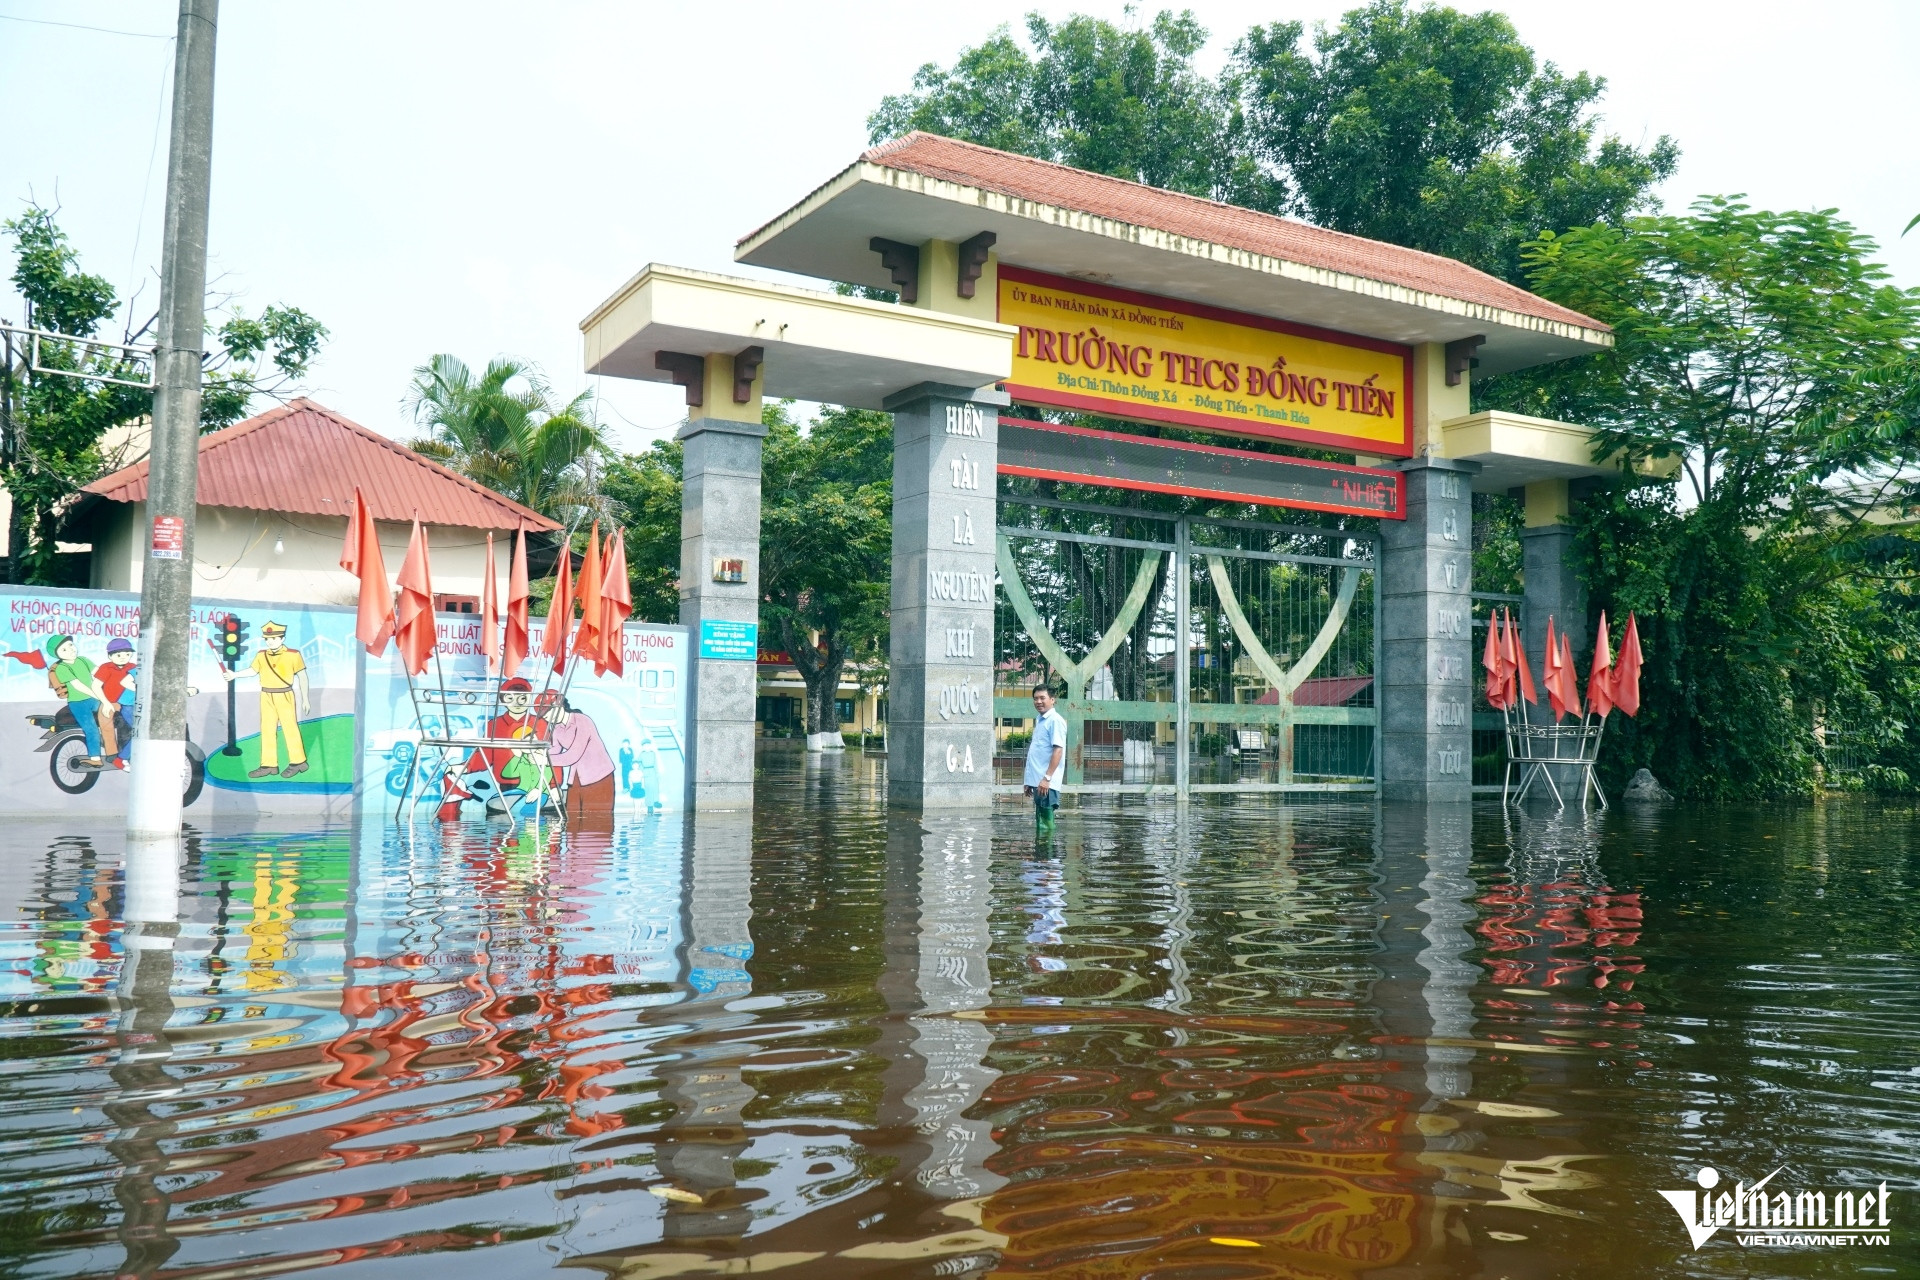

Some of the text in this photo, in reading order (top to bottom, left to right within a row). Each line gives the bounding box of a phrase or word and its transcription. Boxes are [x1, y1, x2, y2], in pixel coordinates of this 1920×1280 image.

[1012, 287, 1184, 331] ỦY BAN NHÂN DÂN XÃ ĐỒNG TIẾN
[1016, 324, 1396, 419] TRƯỜNG THCS ĐỒNG TIẾN
[1057, 372, 1076, 388] Địa
[1100, 380, 1129, 395] Thôn
[1161, 389, 1177, 403] Xá
[1255, 404, 1288, 420] Thanh
[1290, 410, 1310, 424] Hóa
[945, 403, 984, 437] HIỀN
[951, 452, 979, 490] TÀI
[953, 509, 975, 545] LÀ
[930, 566, 990, 602] NGUYÊN
[11, 599, 60, 616] KHÔNG
[65, 601, 111, 618] PHÓNG
[10, 616, 26, 633] VÀ
[29, 616, 55, 634] CHỞ
[58, 618, 84, 635] QUÁ
[86, 619, 104, 636] SỐ
[105, 620, 140, 638] NGƯỜ
[451, 623, 482, 641] LUẬT
[633, 633, 674, 648] THÔNG
[945, 622, 975, 657] KHÍ
[938, 675, 979, 720] QUỐC
[1435, 696, 1465, 727] THÂN
[1438, 744, 1461, 775] YÊU
